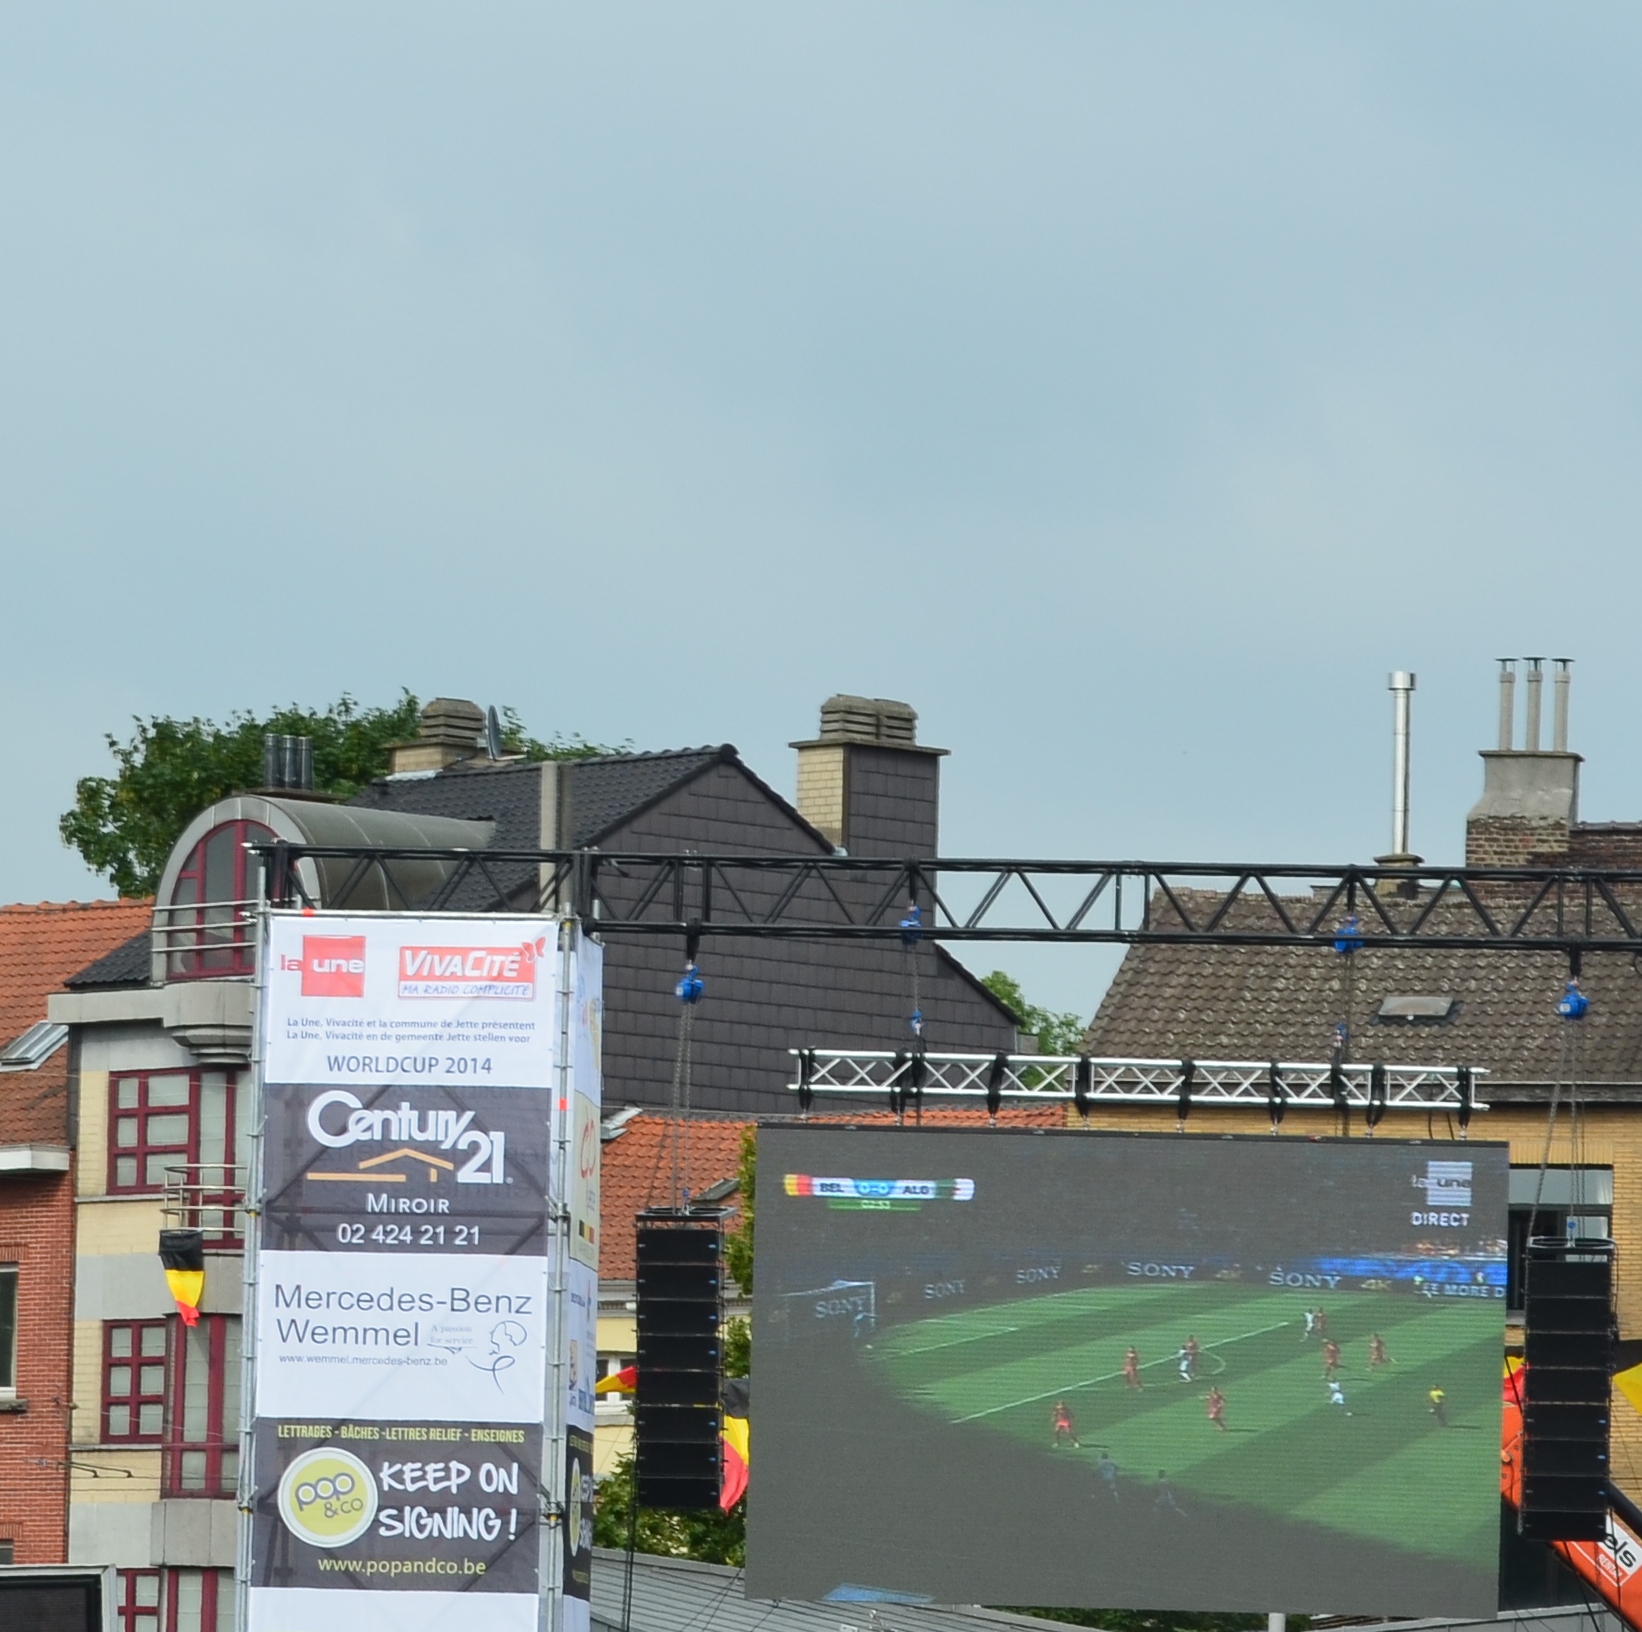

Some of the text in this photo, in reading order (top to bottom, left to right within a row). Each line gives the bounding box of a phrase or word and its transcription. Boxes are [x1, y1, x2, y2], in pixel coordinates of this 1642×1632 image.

[280, 953, 365, 974] la une
[423, 984, 460, 995] RADIO
[287, 1017, 298, 1027] La
[366, 1019, 376, 1028] et
[378, 1019, 387, 1028] la
[389, 1020, 438, 1029] commune
[440, 1019, 453, 1029] de
[455, 1019, 479, 1029] Jette
[286, 1030, 298, 1040] La
[365, 1032, 378, 1041] en
[380, 1031, 393, 1041] de
[395, 1032, 444, 1044] gemeente
[446, 1032, 471, 1042] Jette
[472, 1032, 506, 1043] stellen
[508, 1034, 531, 1043] voor
[326, 1055, 493, 1075] WORLDCUP 2014
[307, 1090, 505, 1184] Century 21
[819, 1182, 844, 1194] BEL
[902, 1184, 930, 1195] ALG
[366, 1192, 450, 1214] MIROIR
[1410, 1211, 1470, 1227] DIRECT
[337, 1222, 480, 1246] 02 424 21 21
[1016, 1265, 1061, 1284] SONY
[1126, 1261, 1195, 1279] SONY
[1269, 1271, 1341, 1289] SONY
[274, 1283, 533, 1315] Mercedes-Benz
[276, 1318, 420, 1347] Wemmel
[278, 1353, 448, 1367] www.wemmel.mercedes-benz.be
[277, 1424, 333, 1440] LETTRAGES
[429, 1428, 463, 1442] RELIEF
[471, 1429, 525, 1444] ENSEIGNES
[379, 1460, 519, 1495] KEEP ON
[295, 1472, 356, 1512] pop
[317, 1557, 487, 1578] www.popandco.be
